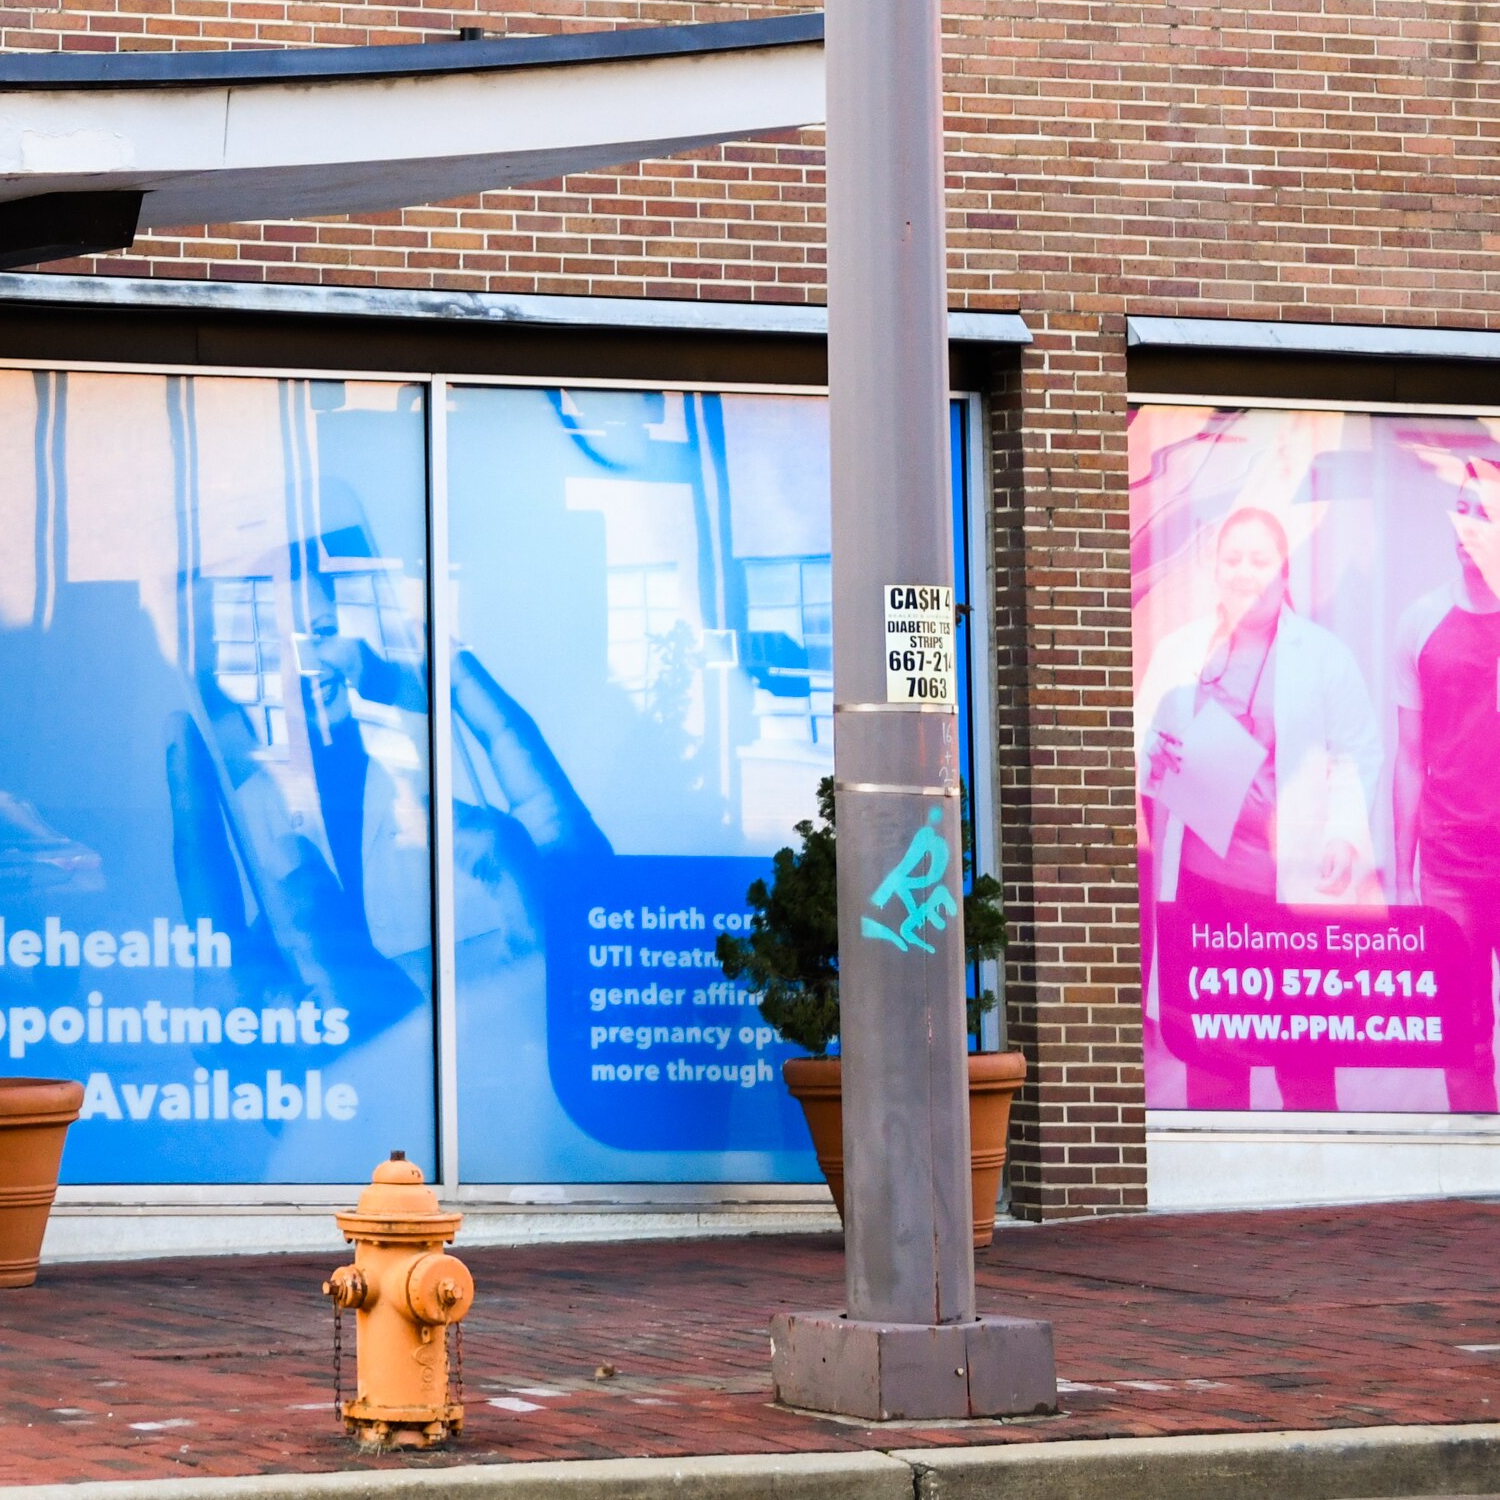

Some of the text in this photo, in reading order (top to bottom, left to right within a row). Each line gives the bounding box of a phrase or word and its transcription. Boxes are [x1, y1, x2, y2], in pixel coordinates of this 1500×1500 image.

[890, 587, 940, 612] CA$H
[888, 621, 936, 634] DIABETIC
[910, 636, 943, 649] STRIPS
[906, 677, 947, 699] 7063
[588, 907, 634, 929] Get
[641, 906, 705, 930] birth
[1192, 923, 1425, 957] Hablamos Español
[589, 945, 632, 967] UTI
[1188, 966, 1438, 1001] (410) 576-1414
[590, 982, 684, 1012] gender
[591, 1026, 732, 1050] pregnancy
[1191, 1013, 1442, 1042] WWW.PPM.CARE
[591, 1059, 774, 1088] more through
[80, 1069, 359, 1122] Available
